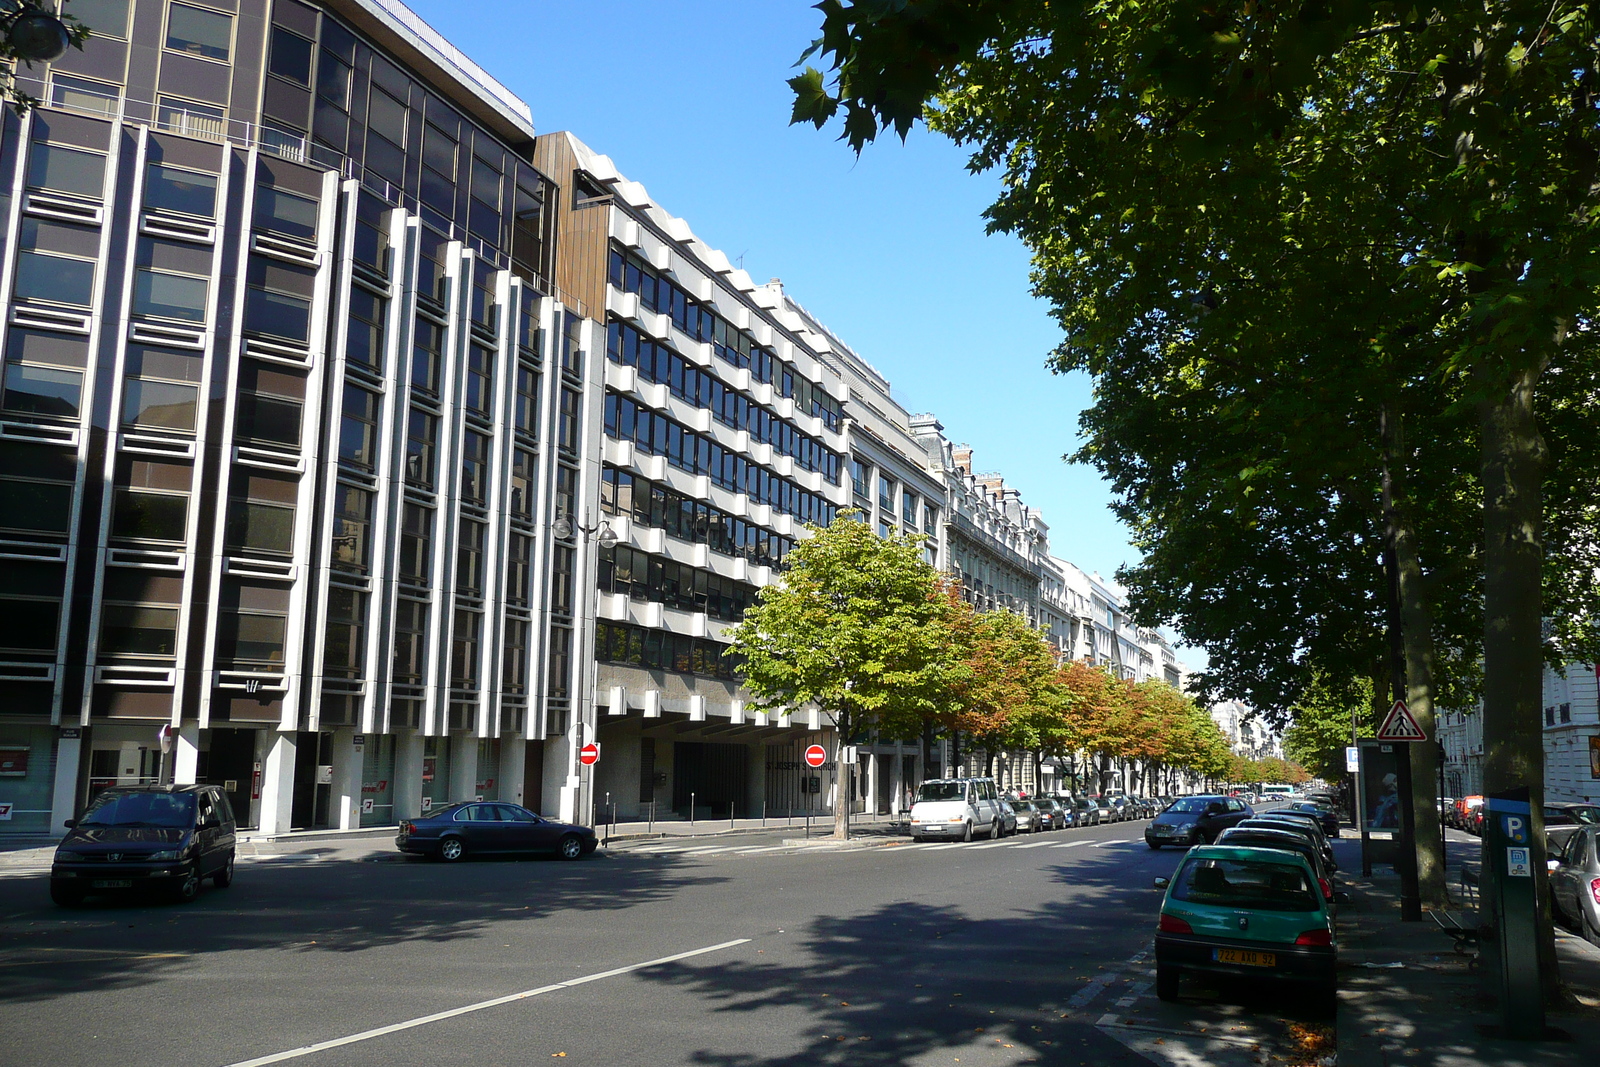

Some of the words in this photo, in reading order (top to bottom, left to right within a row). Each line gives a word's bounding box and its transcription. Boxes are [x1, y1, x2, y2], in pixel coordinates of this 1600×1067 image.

[775, 762, 806, 770] JOSEPH'S
[1507, 817, 1522, 838] P
[1219, 949, 1236, 961] 722
[1262, 953, 1273, 965] 92
